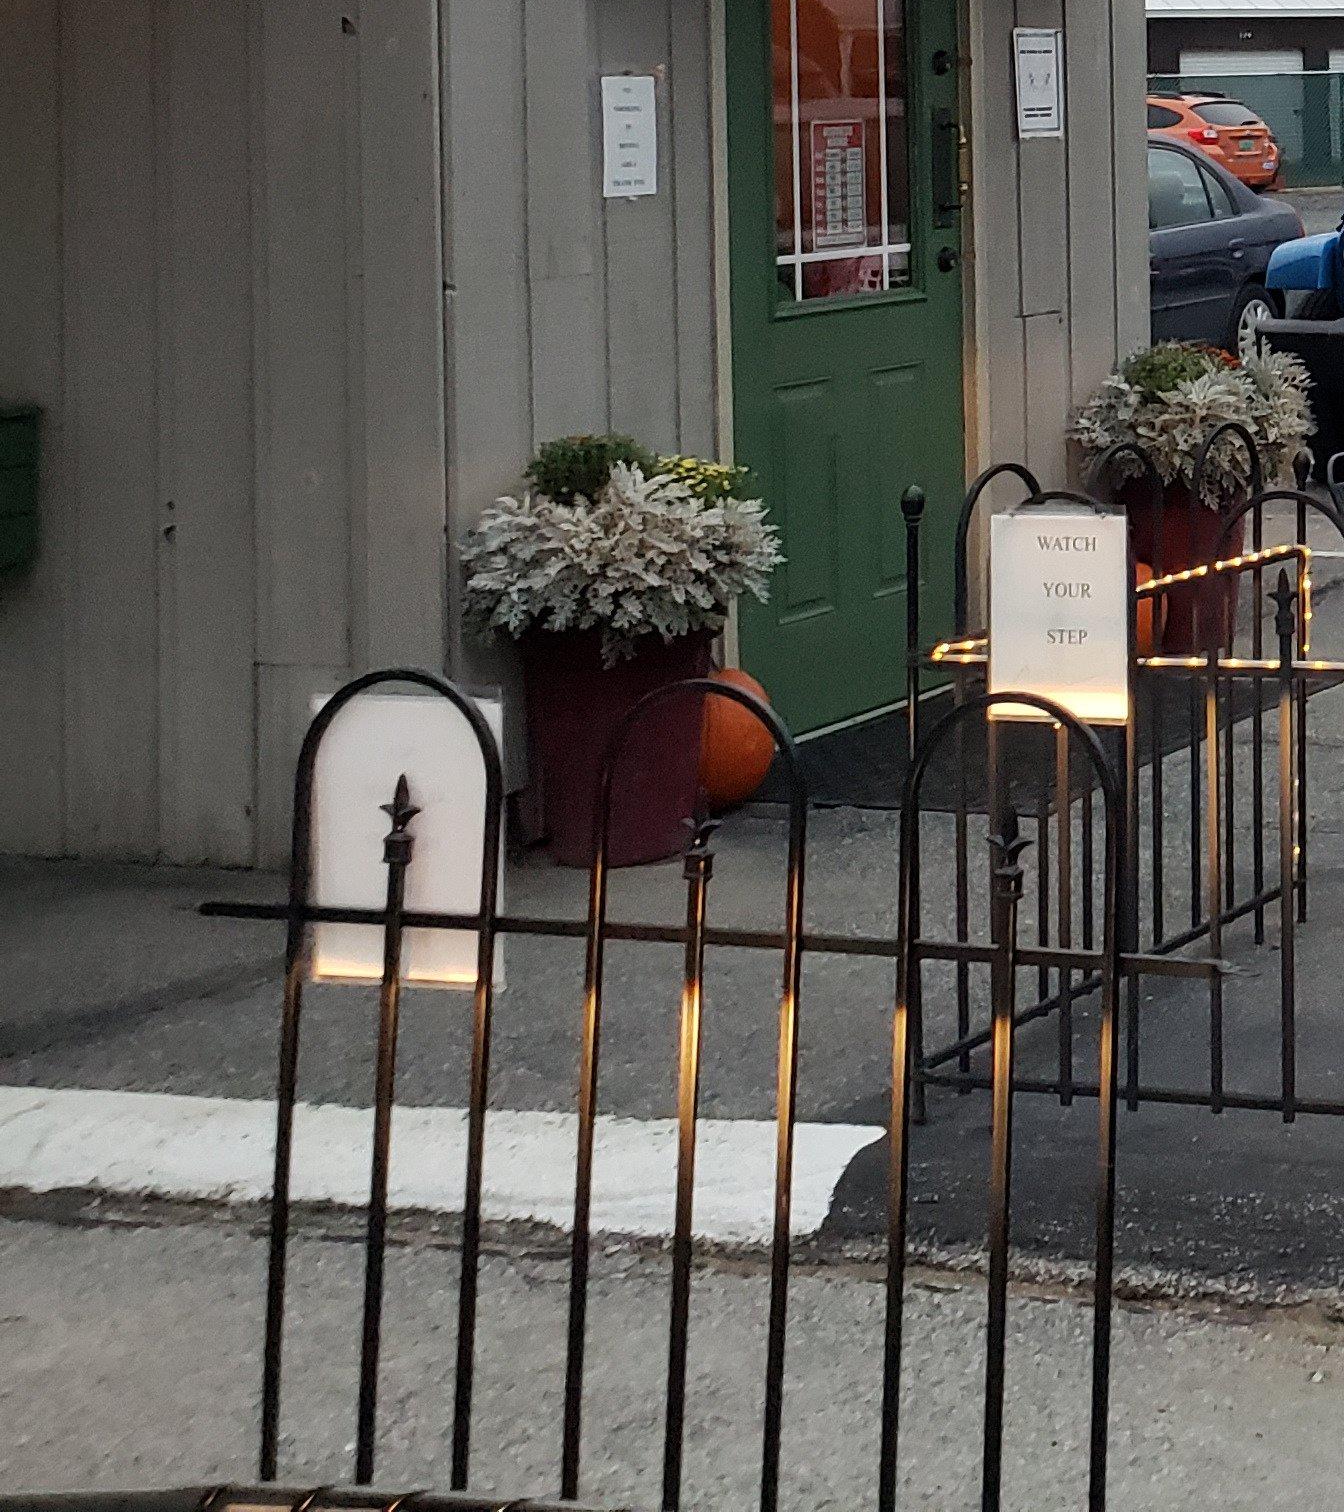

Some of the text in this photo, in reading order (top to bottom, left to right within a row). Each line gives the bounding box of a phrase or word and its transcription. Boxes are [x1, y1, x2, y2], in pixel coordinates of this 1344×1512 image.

[1037, 536, 1097, 552] WATCH
[1042, 582, 1092, 599] YOUR
[1046, 629, 1089, 645] STEP
